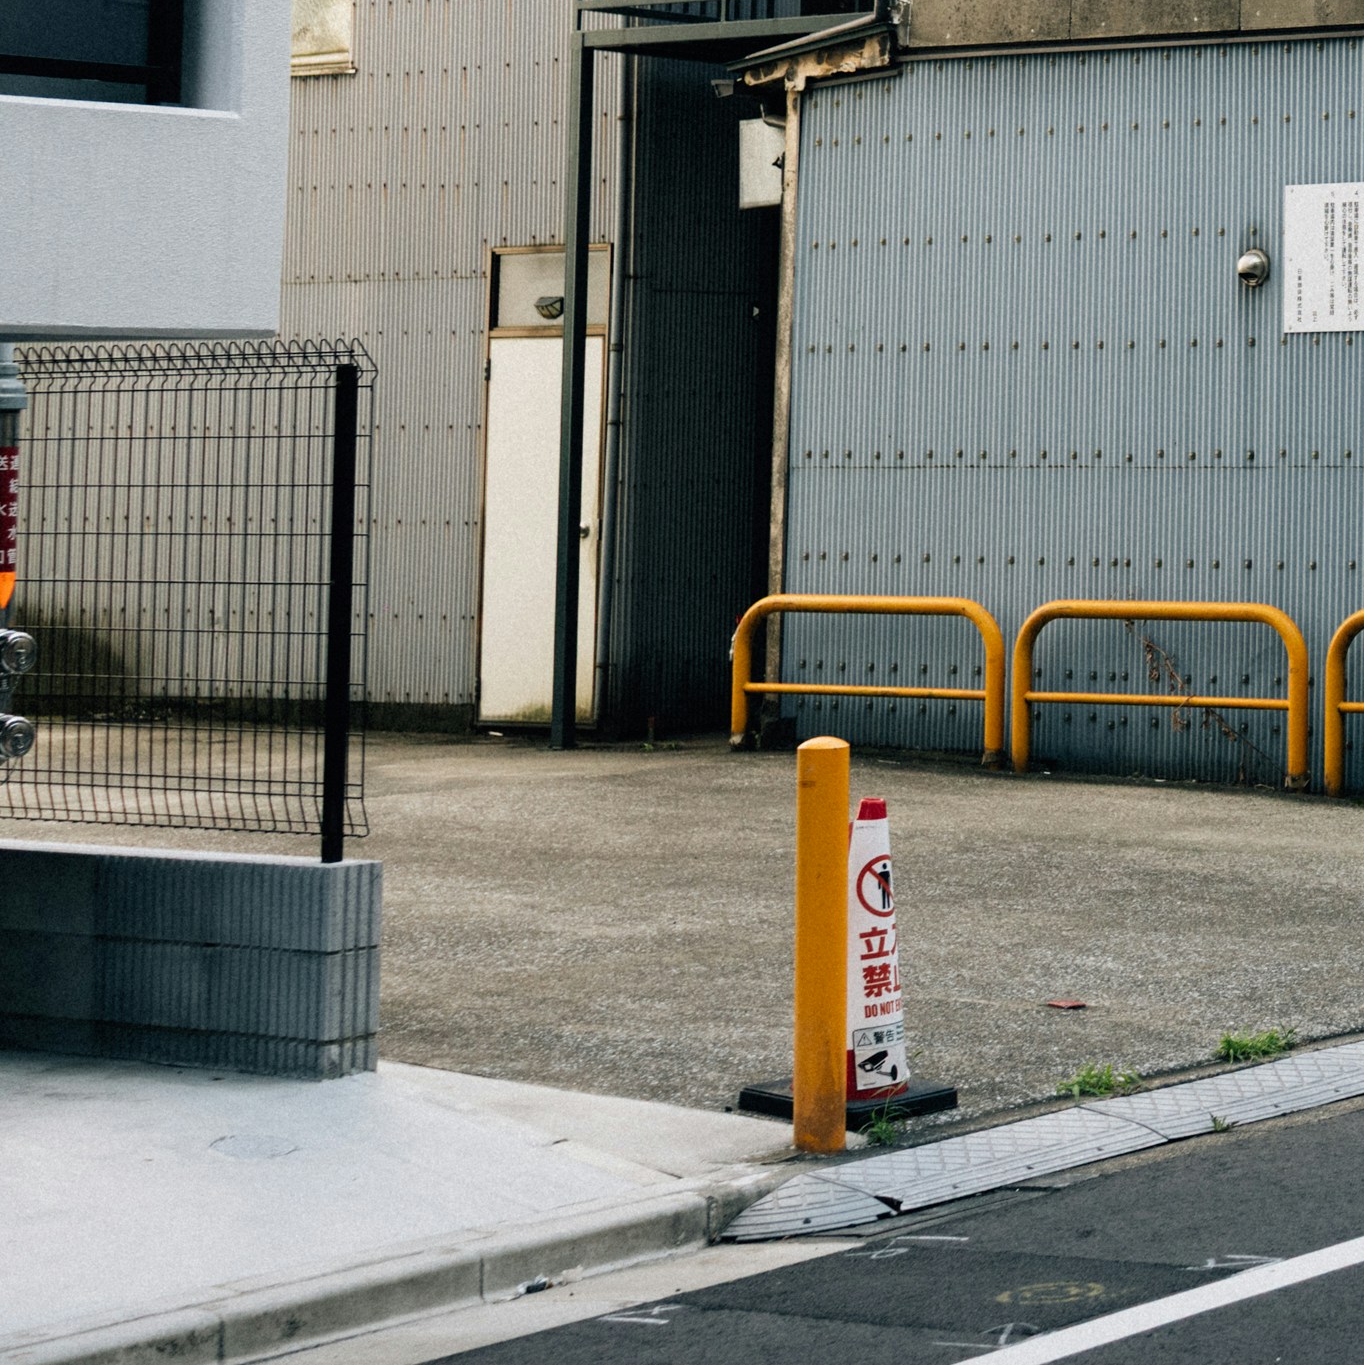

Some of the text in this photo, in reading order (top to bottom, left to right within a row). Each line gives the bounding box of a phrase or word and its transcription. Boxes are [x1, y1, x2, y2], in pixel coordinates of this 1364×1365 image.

[864, 1004, 878, 1019] DO
[880, 1000, 895, 1016] NOT
[873, 1028, 895, 1045] 警告
